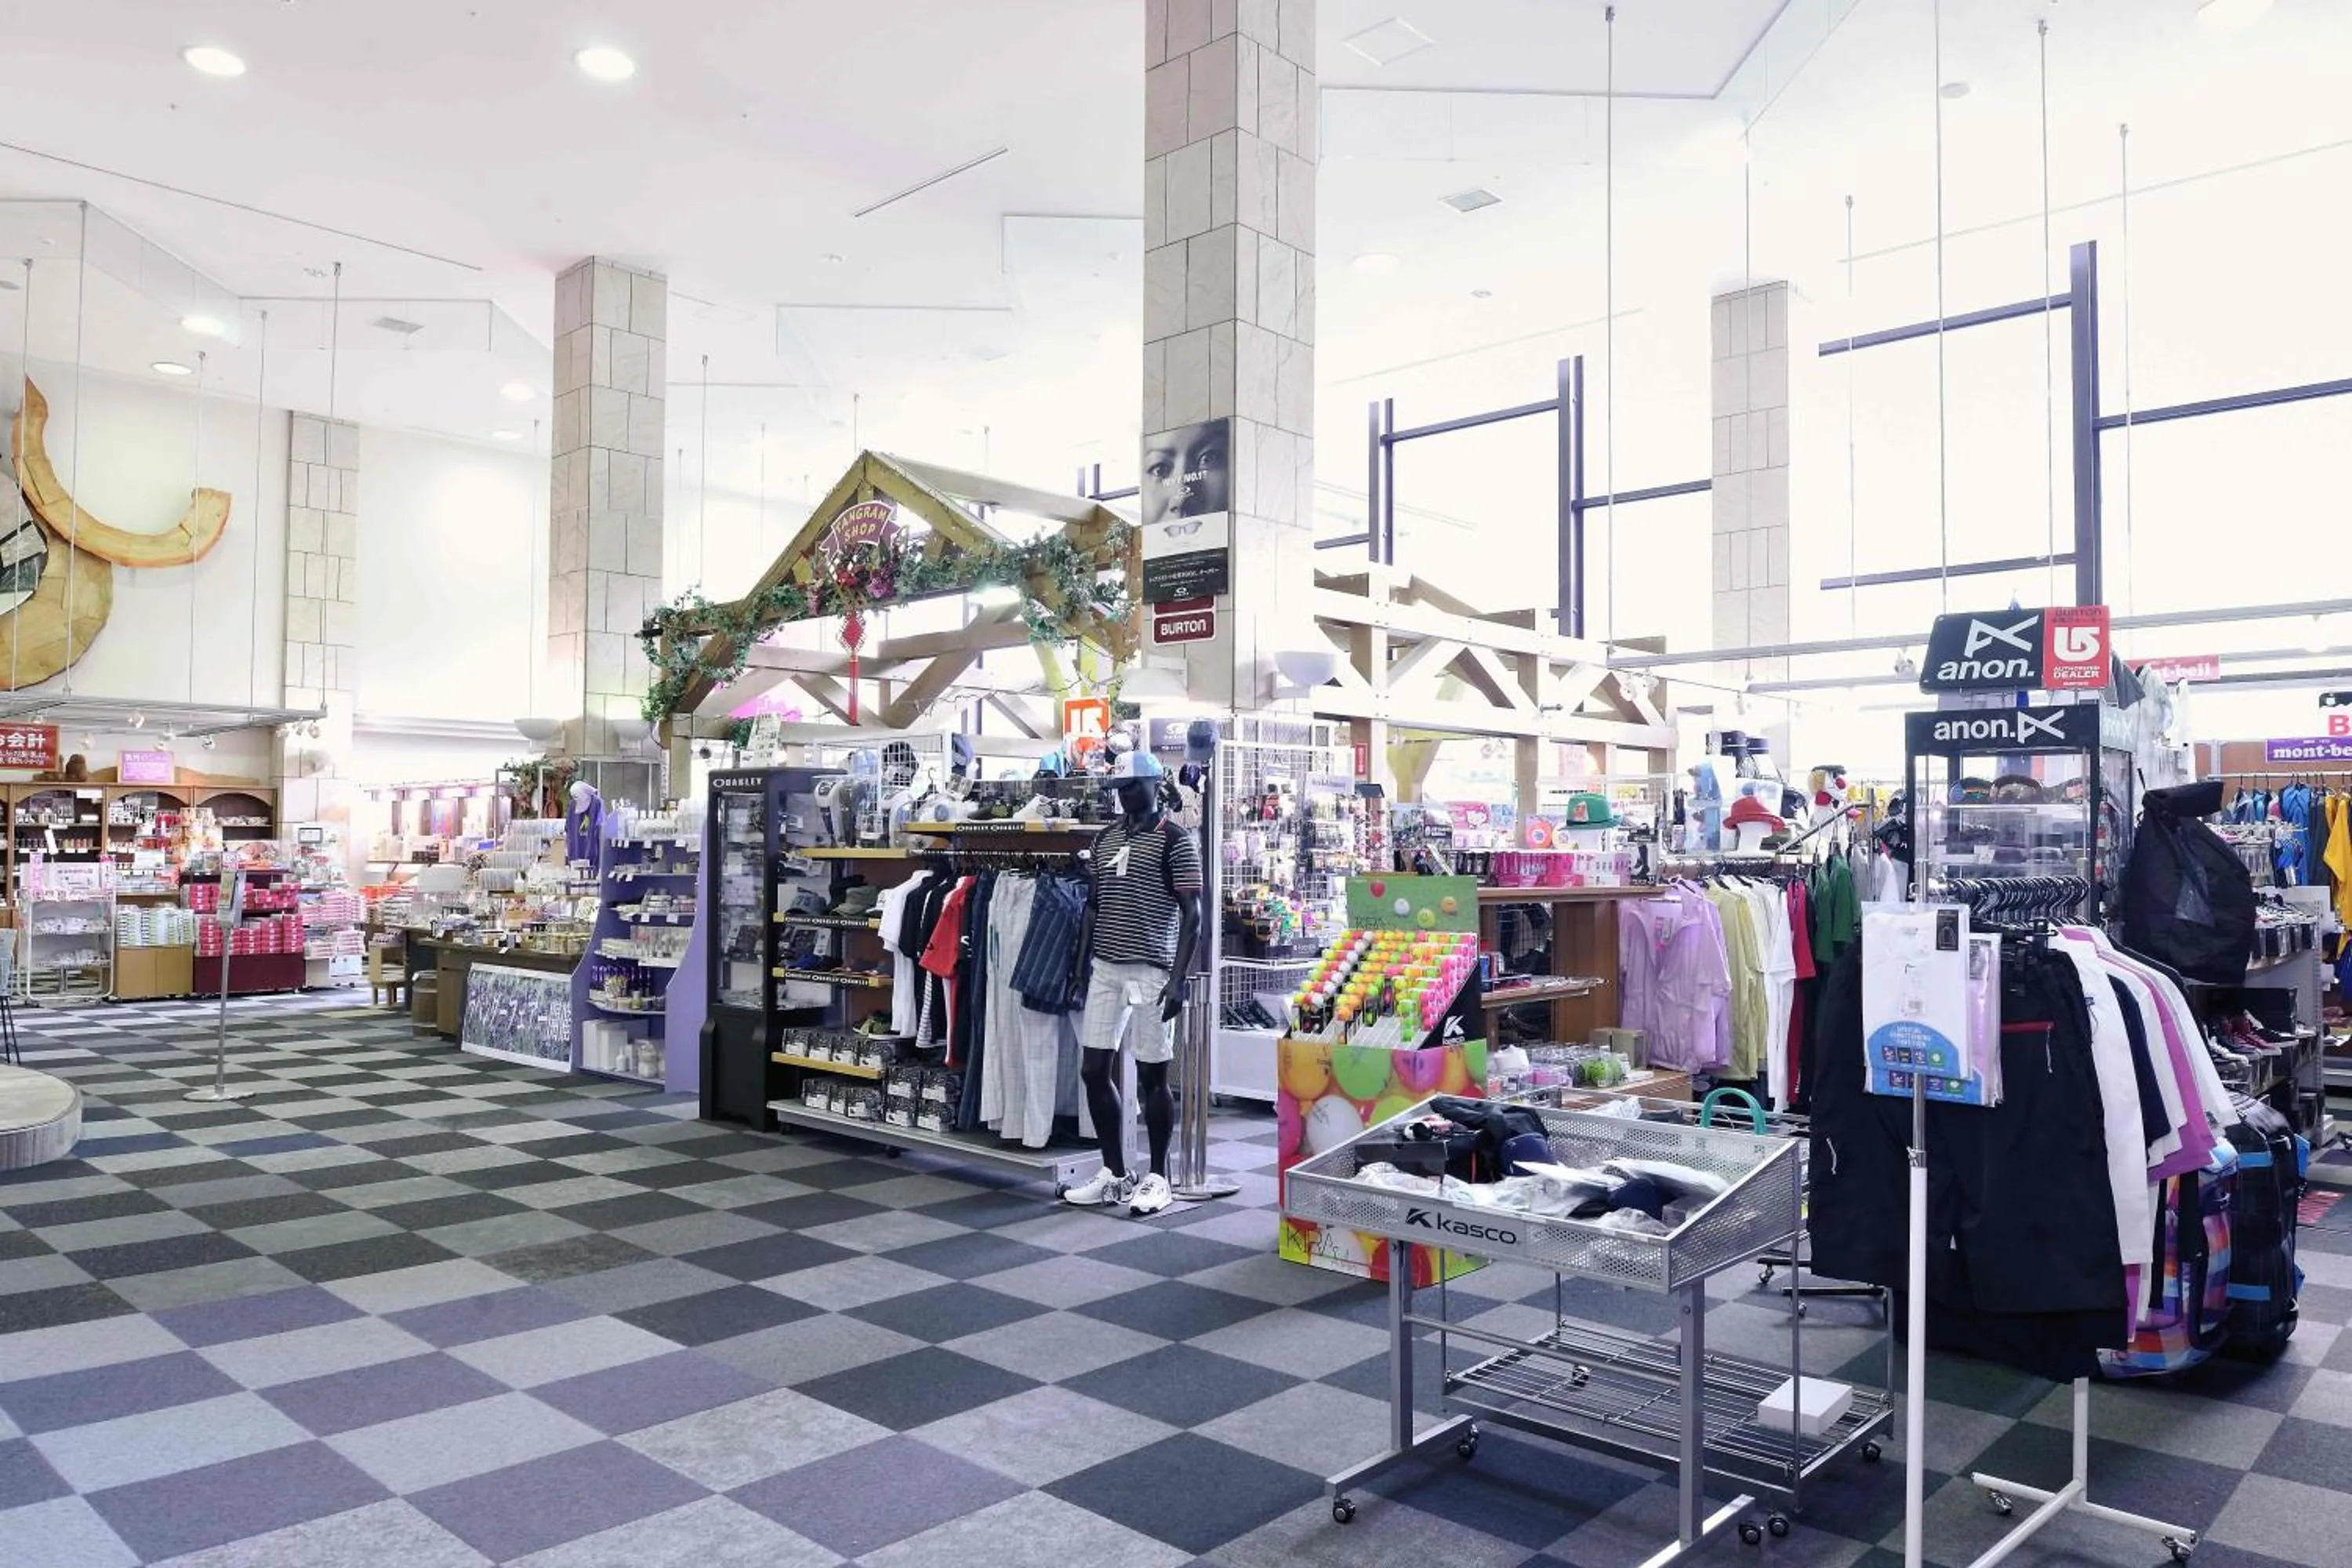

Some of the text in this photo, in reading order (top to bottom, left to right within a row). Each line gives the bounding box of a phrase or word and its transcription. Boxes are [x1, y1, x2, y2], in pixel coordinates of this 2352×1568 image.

[835, 505, 887, 533] TANGRAM
[844, 521, 877, 542] SHOP
[1161, 619, 1207, 636] BURTON
[2053, 670, 2099, 679] DEALER
[725, 777, 764, 787] OAKLEY
[1436, 1211, 1517, 1245] kasco
